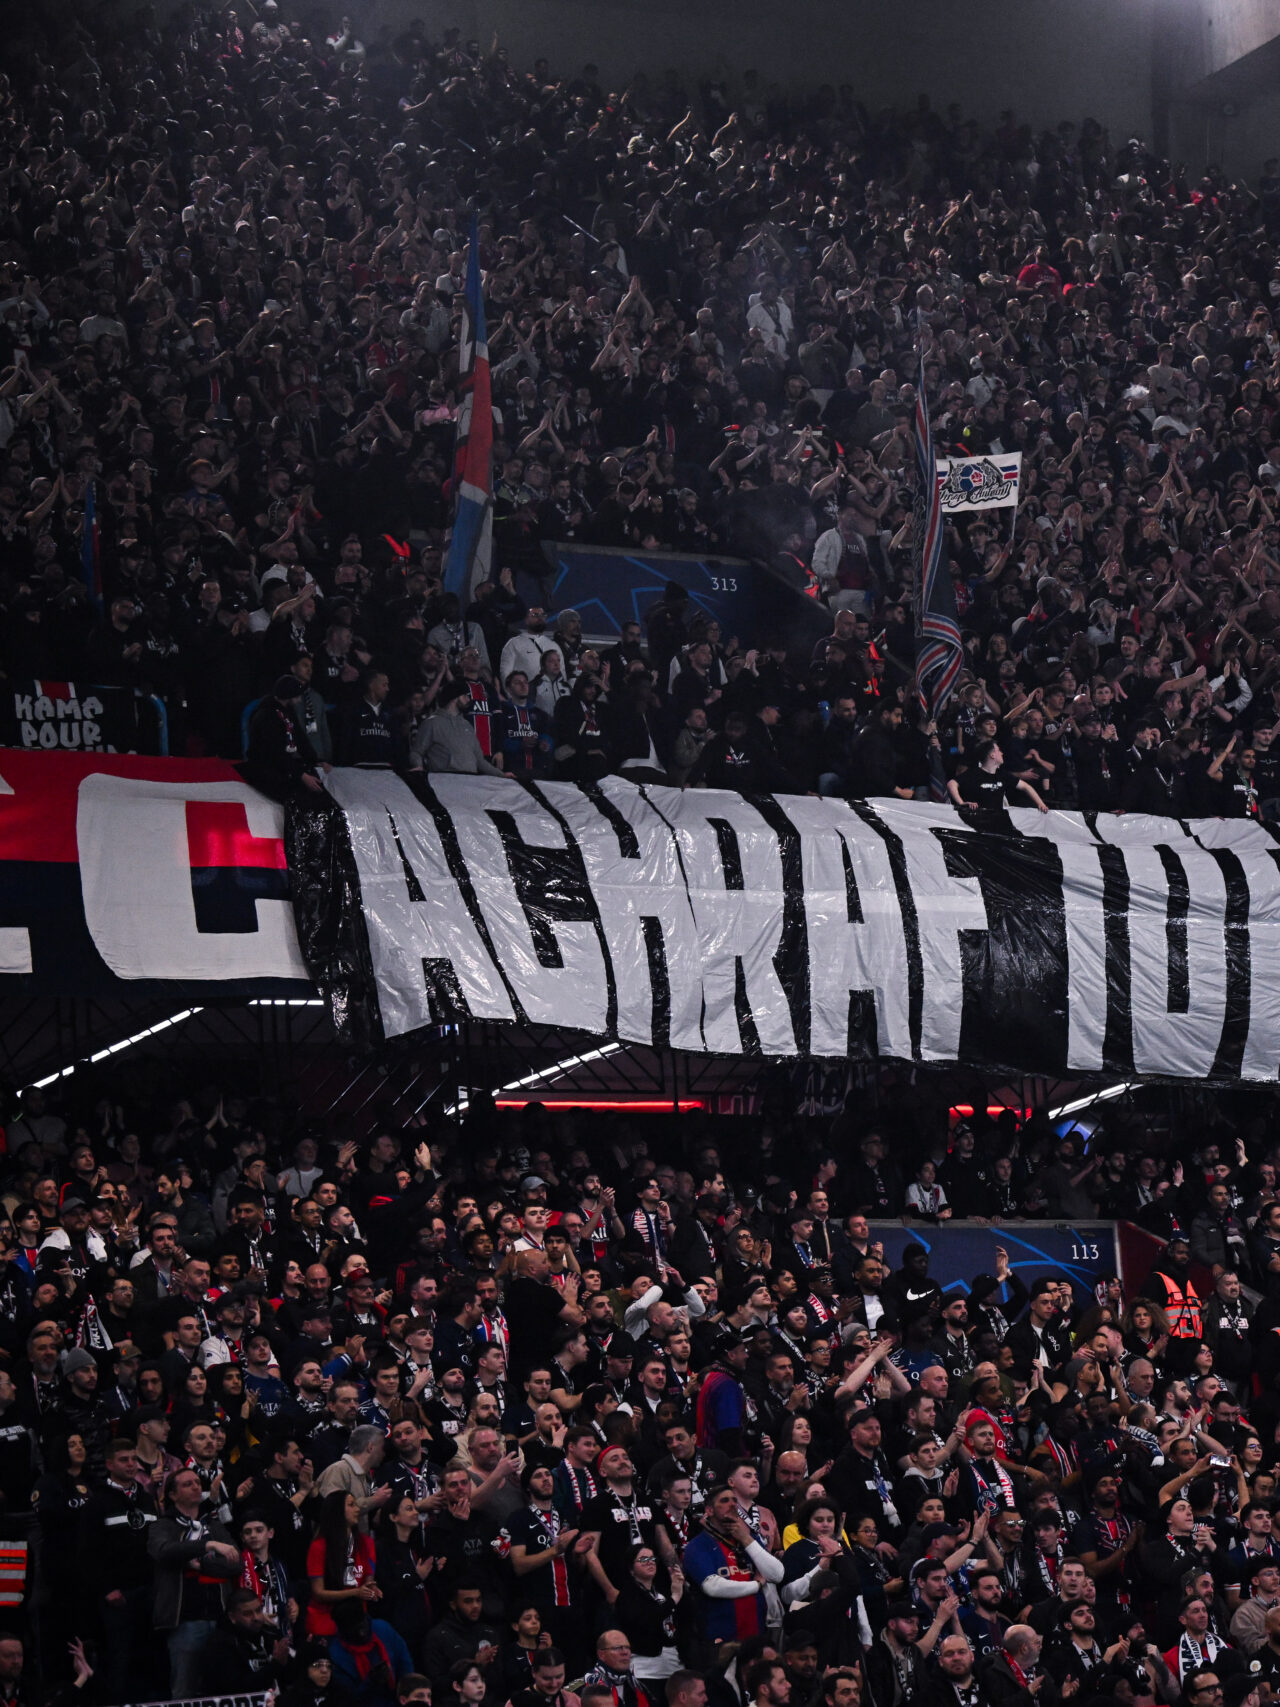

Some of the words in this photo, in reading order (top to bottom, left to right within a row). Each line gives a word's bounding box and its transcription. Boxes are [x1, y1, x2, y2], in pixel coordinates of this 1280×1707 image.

[711, 576, 738, 592] 313
[14, 692, 104, 721] KAMA
[21, 719, 102, 748] POUR
[0, 772, 312, 981] C
[320, 765, 989, 1064] ACHRAF
[1071, 1244, 1100, 1261] 113
